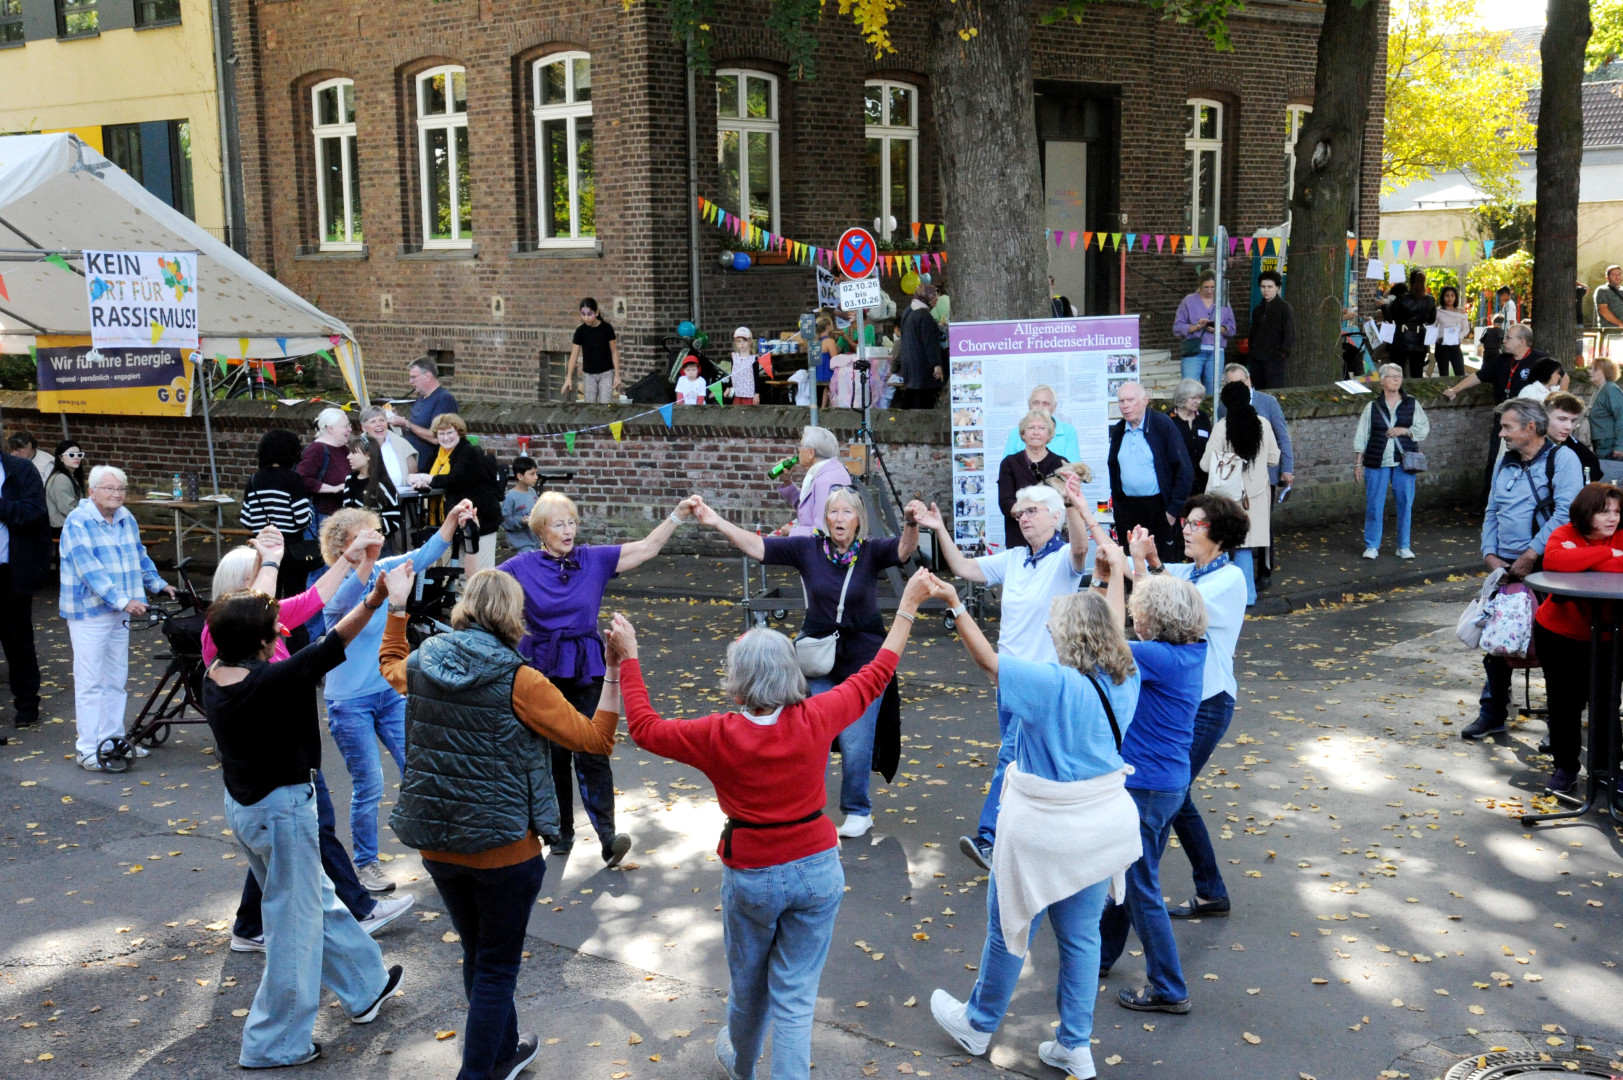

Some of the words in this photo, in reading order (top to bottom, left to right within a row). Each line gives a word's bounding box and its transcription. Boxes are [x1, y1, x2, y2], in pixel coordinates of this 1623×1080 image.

[87, 253, 141, 275] KEIN
[132, 276, 165, 302] FÜR
[843, 281, 878, 292] 02.10.26
[844, 296, 879, 307] 03.10.26
[92, 306, 196, 329] RASSISMUS!
[1013, 323, 1077, 337] Allgemeine
[958, 337, 1023, 352] Chorweiler
[1027, 333, 1133, 349] Friedenserklärung
[50, 356, 73, 371] Wir
[125, 350, 175, 368] Energie.
[55, 375, 77, 384] regional
[80, 374, 110, 383] persönlich
[113, 373, 142, 381] engagiert
